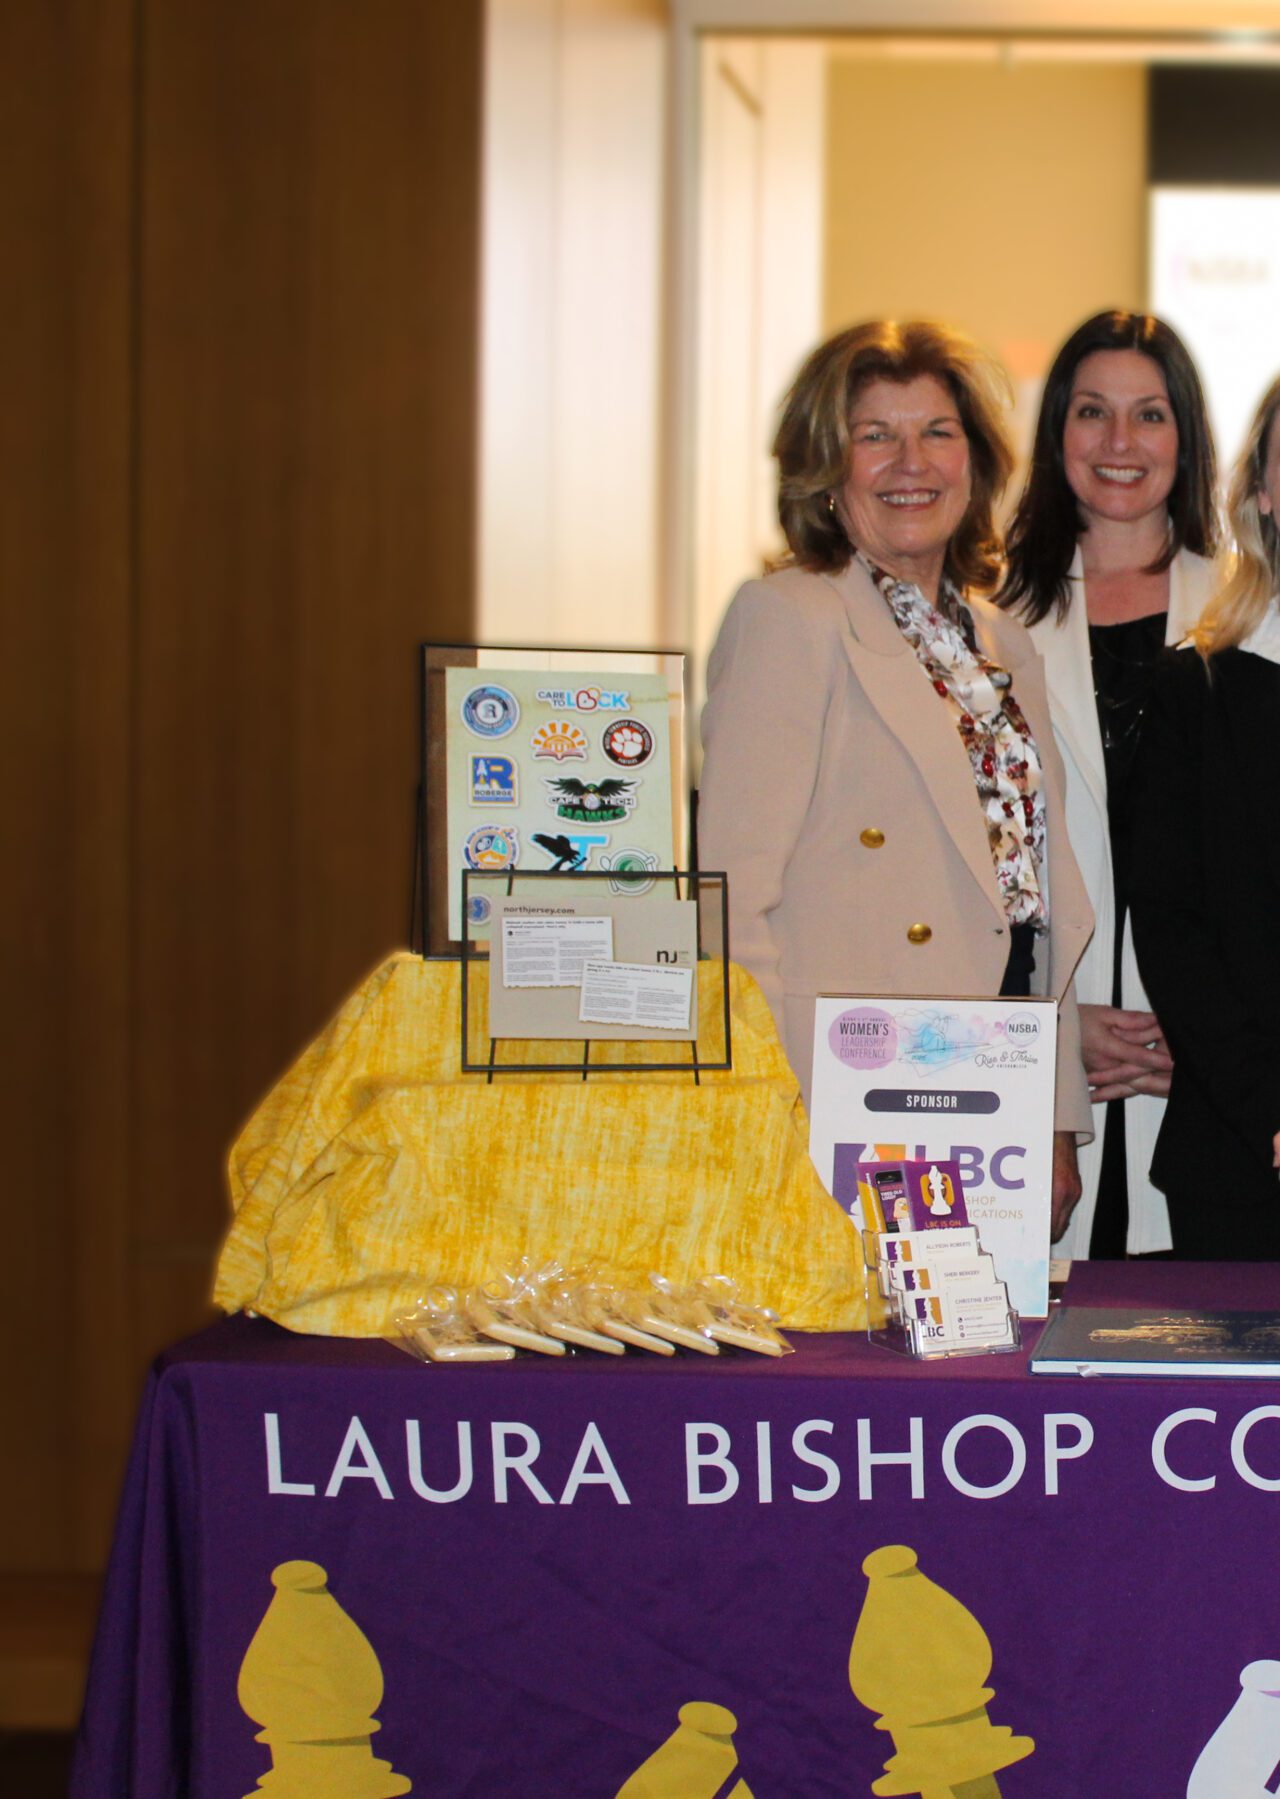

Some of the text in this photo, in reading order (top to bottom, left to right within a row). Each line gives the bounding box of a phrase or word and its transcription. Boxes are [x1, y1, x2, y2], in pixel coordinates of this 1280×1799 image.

[538, 691, 565, 699] CARE
[553, 699, 566, 707] TO
[557, 804, 627, 823] HAWKS
[503, 905, 576, 915] northjersey.com
[840, 1022, 889, 1036] WOMEN'S
[1008, 1023, 1038, 1033] NJSBA
[841, 1036, 887, 1048] LEADERSHIP
[840, 1048, 887, 1059] CONFERENCE
[906, 1094, 957, 1108] SPONSOR
[265, 1414, 630, 1504] LAURA
[686, 1413, 1093, 1504] BISHOP
